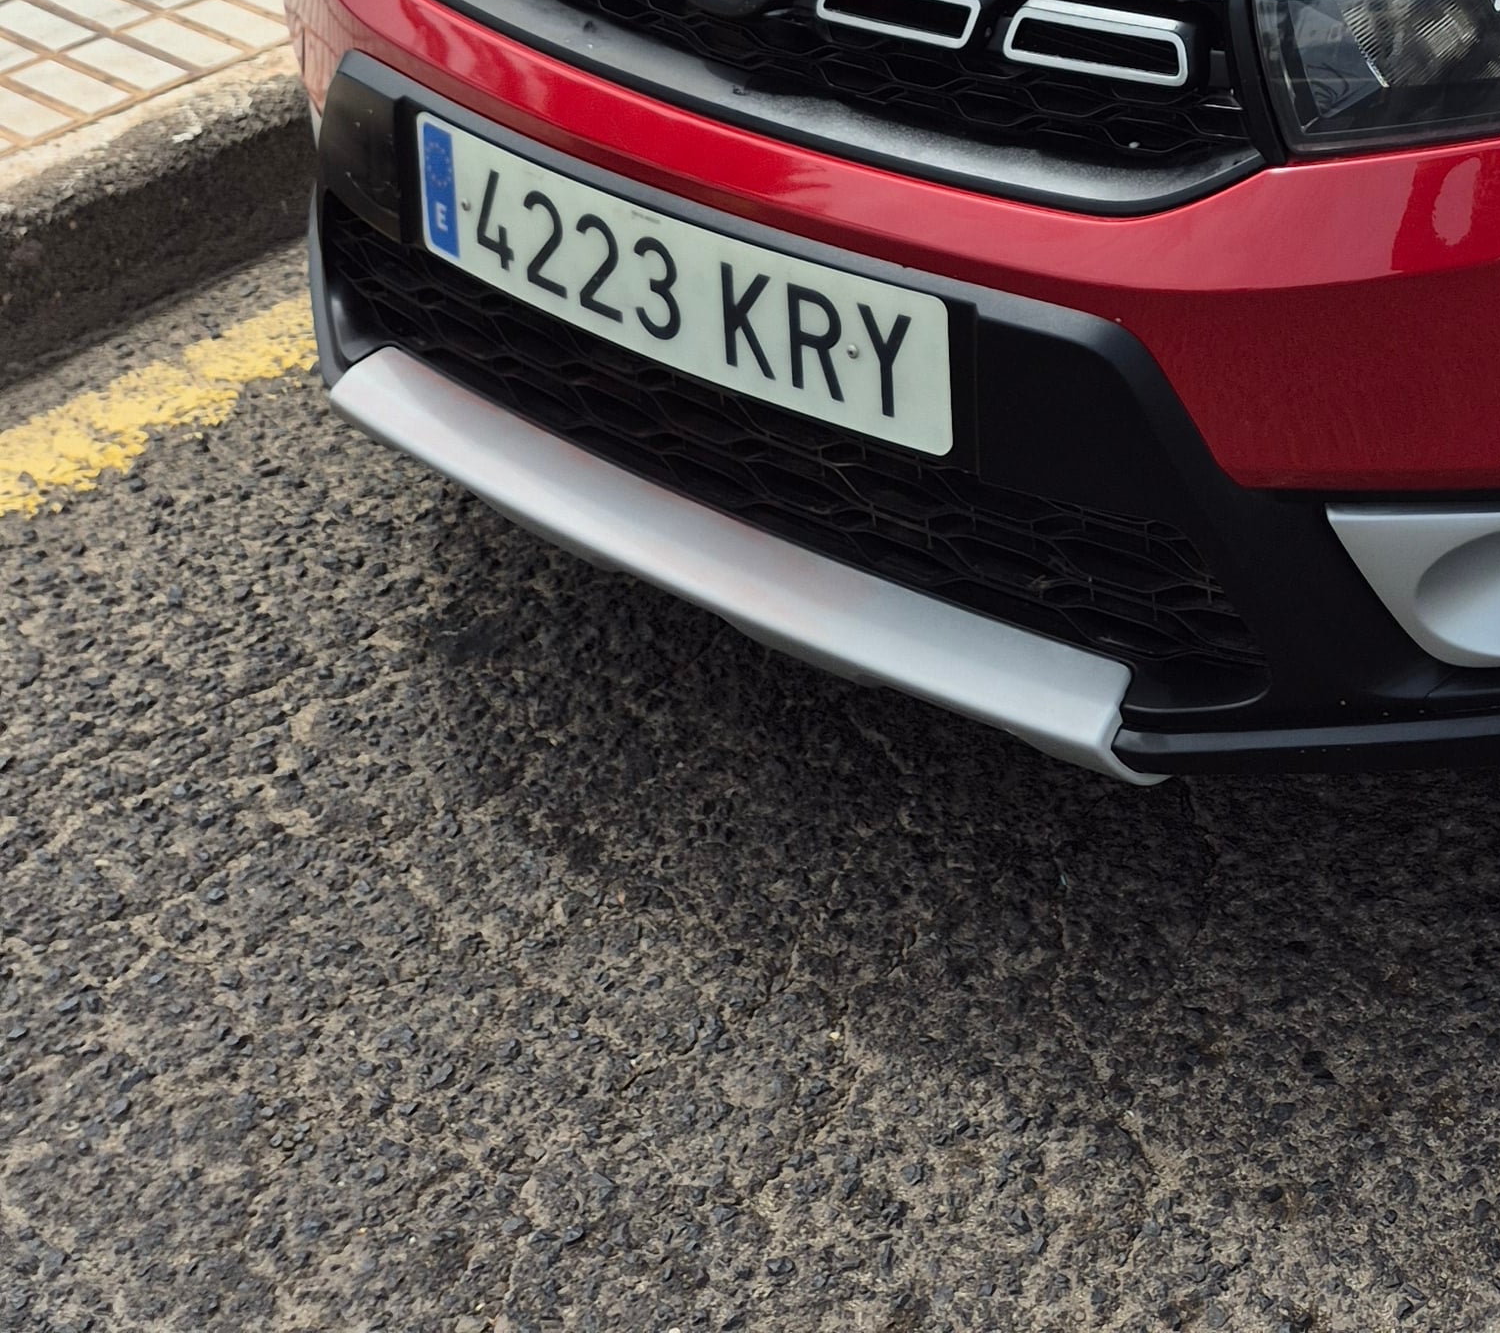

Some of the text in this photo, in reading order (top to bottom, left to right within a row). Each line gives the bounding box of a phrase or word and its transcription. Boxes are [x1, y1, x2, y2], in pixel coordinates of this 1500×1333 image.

[435, 199, 449, 233] E
[475, 169, 913, 418] 4223 KRY
